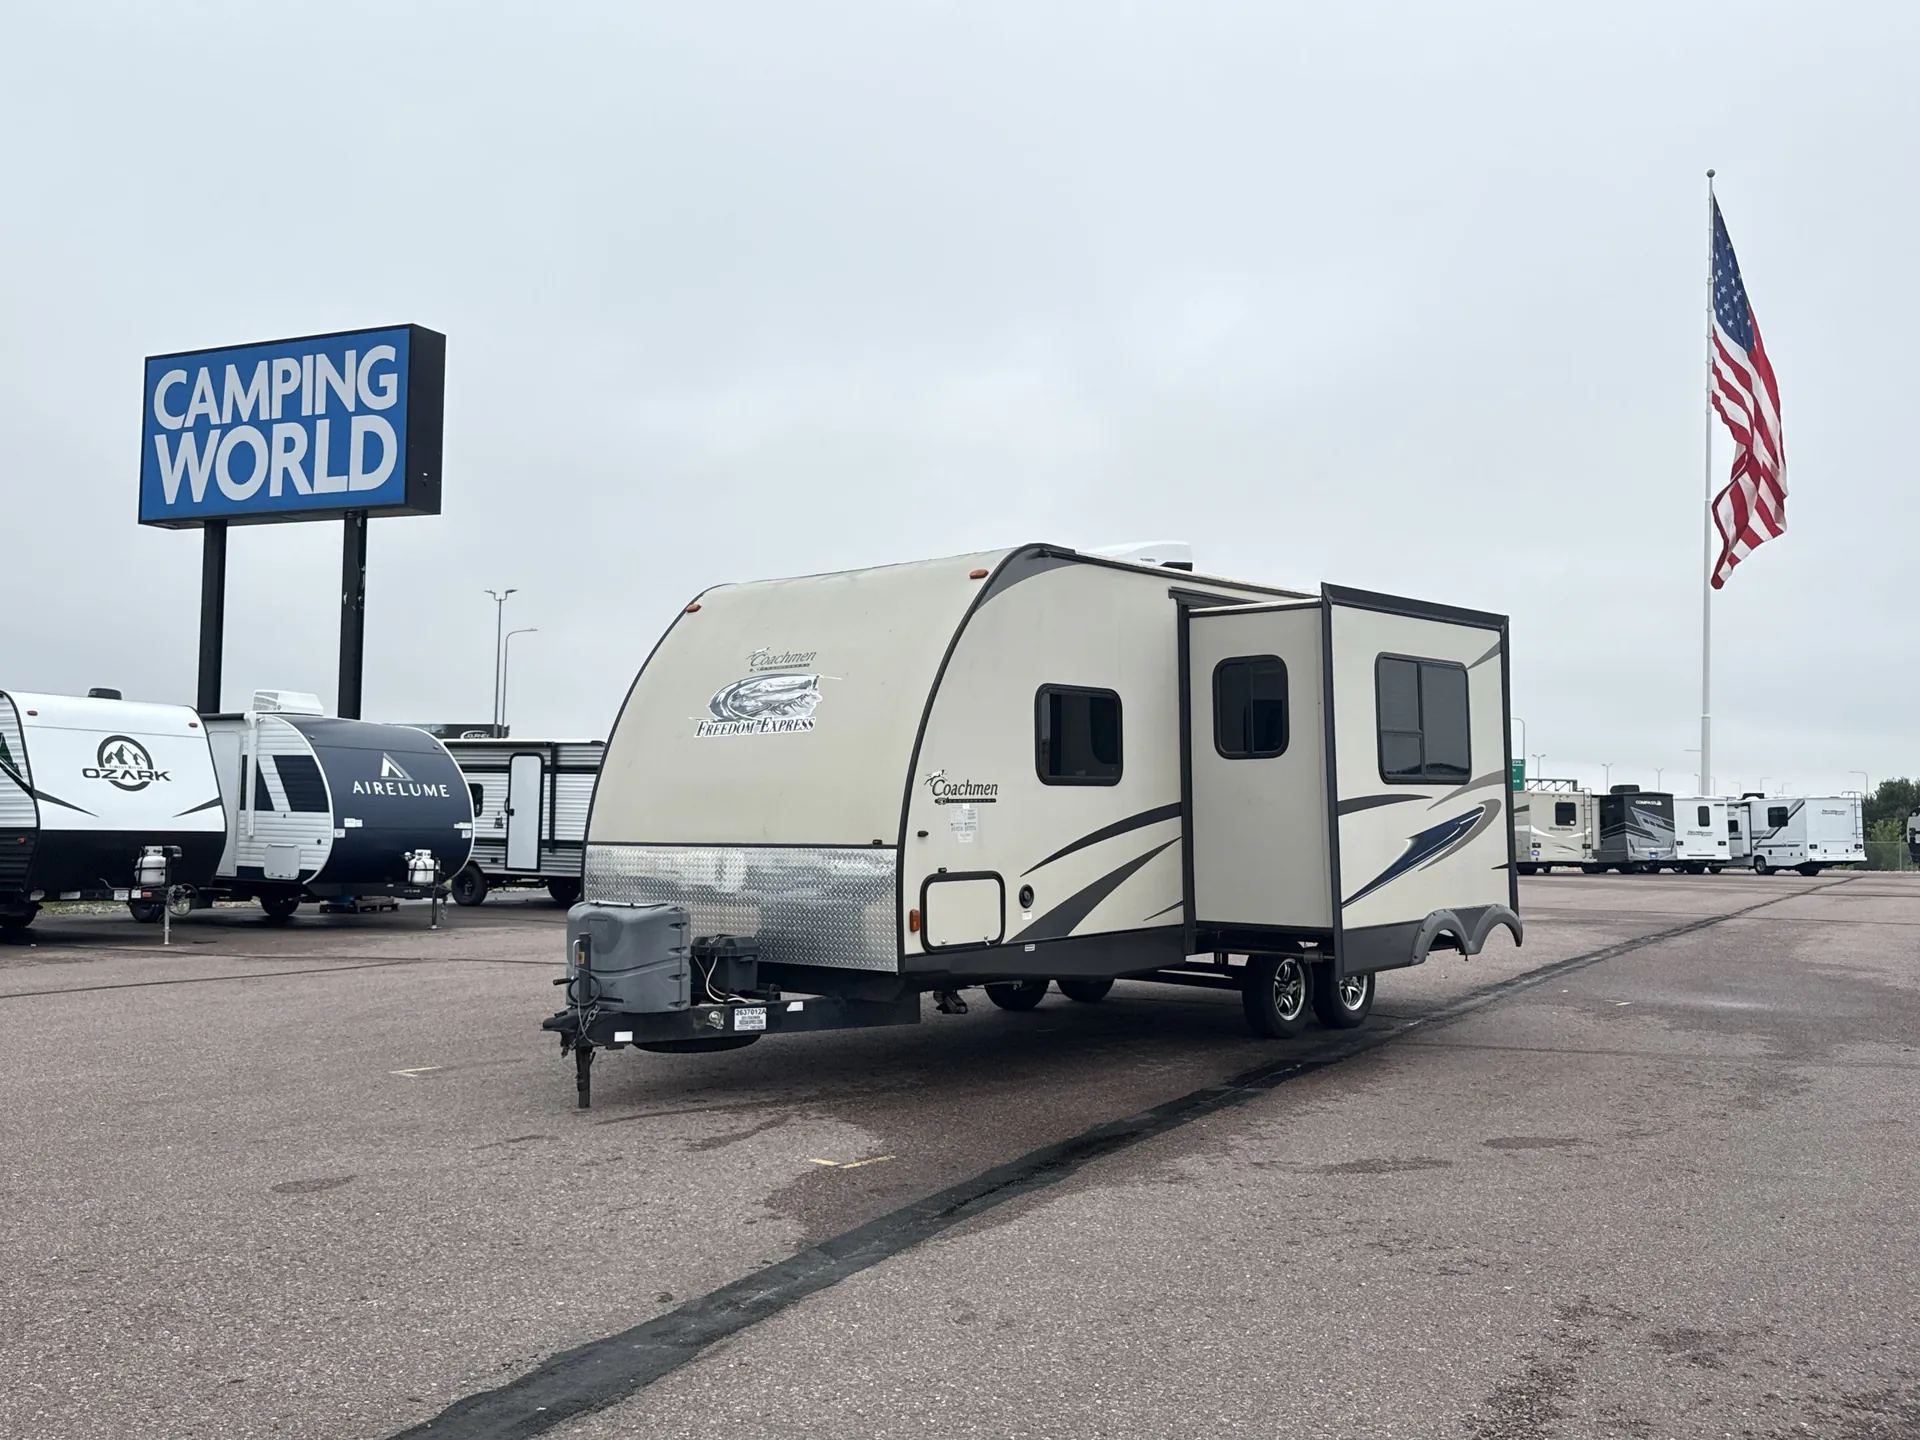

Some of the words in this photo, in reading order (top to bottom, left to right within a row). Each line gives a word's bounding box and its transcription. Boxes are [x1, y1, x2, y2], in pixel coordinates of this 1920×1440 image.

[153, 344, 398, 431] CAMPING
[154, 414, 398, 505] WORLD
[750, 650, 817, 667] Coachmen
[695, 720, 755, 737] FREEDOM
[758, 716, 816, 733] EXPRESS
[82, 767, 172, 782] OZARK
[352, 780, 450, 798] AIRELUME
[932, 779, 998, 796] Coachmen
[735, 1008, 766, 1016] 2637012A
